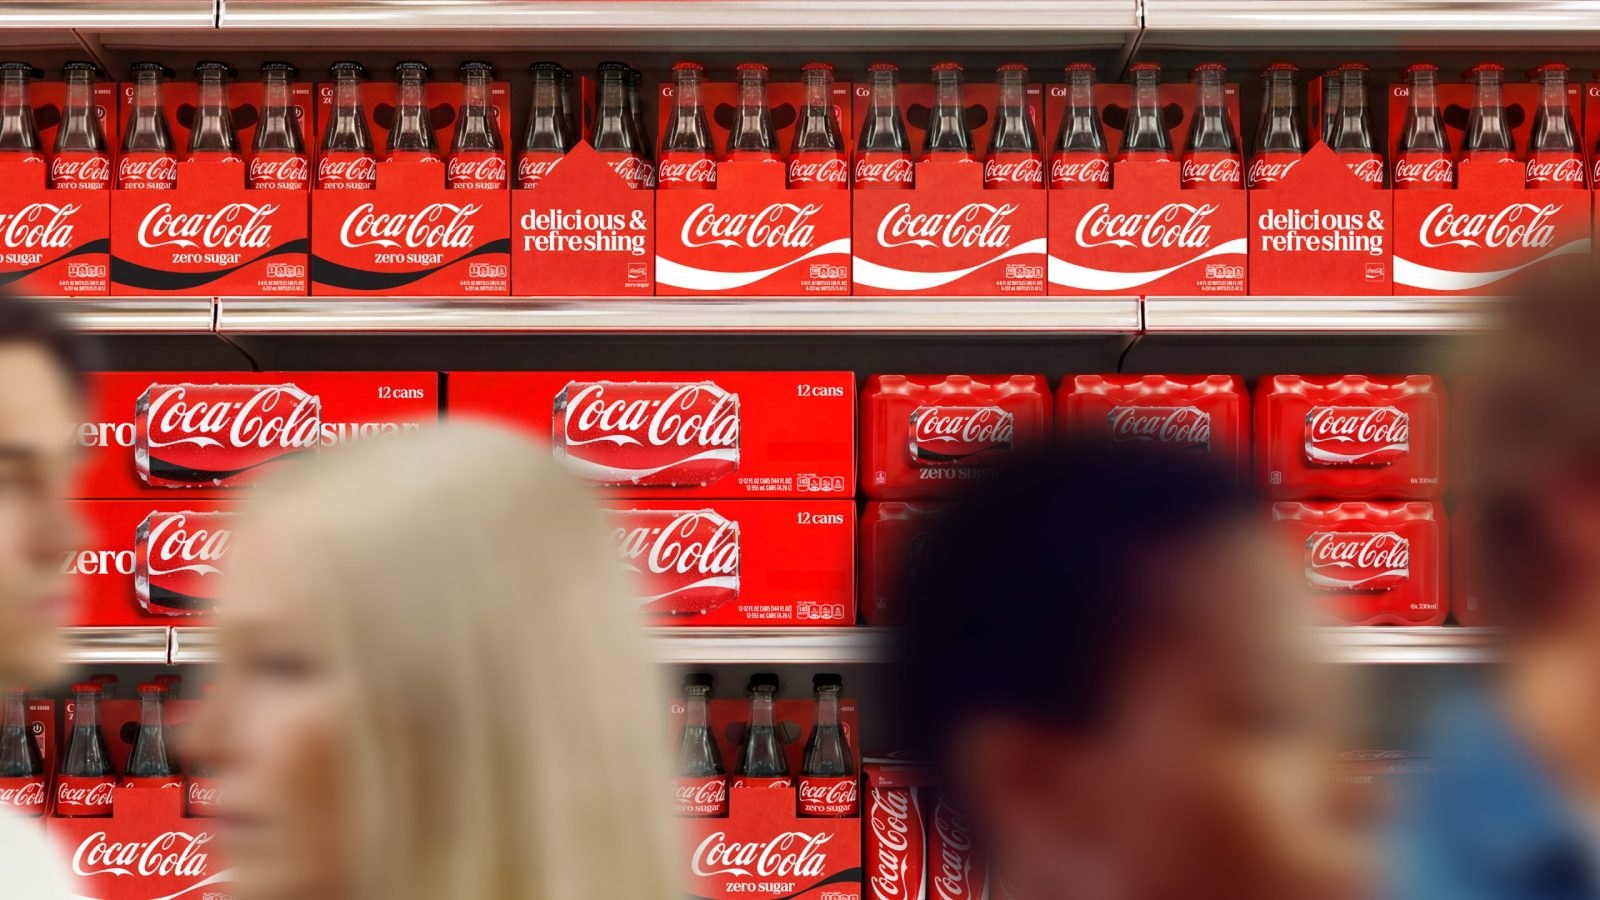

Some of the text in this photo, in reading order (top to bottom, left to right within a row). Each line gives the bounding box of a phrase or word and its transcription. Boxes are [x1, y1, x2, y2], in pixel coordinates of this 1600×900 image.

[52, 157, 109, 180] Coca-Cola
[119, 157, 177, 180] Coca-Cola
[250, 157, 307, 180] Coca-Cola
[319, 157, 376, 180] Coca-Cola
[448, 157, 506, 180] Coca-Cola
[659, 159, 716, 182] Coca-Cola
[789, 159, 847, 182] Coca-Cola
[856, 159, 913, 182] Coca-Cola
[985, 159, 1042, 182] Coca-Cola
[1052, 159, 1109, 182] Coca-Cola
[1182, 159, 1240, 182] Coca-Cola
[1395, 159, 1453, 182] Coca-Cola
[1526, 159, 1583, 182] Coca-Cola
[79, 182, 104, 190] sugar
[147, 182, 172, 190] sugar
[278, 182, 303, 190] sugar
[346, 182, 371, 190] sugar
[475, 182, 501, 190] sugar
[138, 203, 280, 248] Coca-Cola
[340, 203, 483, 248] Coca-Cola
[629, 209, 647, 230] &
[681, 203, 824, 248] Coca-Cola
[877, 203, 1019, 248] Coca-Cola
[1075, 203, 1219, 248] Coca-Cola
[1367, 209, 1385, 230] &
[1419, 203, 1564, 248] Coca-Cola
[6, 253, 42, 265] sugar
[172, 253, 241, 265] zero sugar
[375, 253, 444, 265] zero sugar
[378, 386, 424, 398] 12 cans
[797, 385, 844, 397] 12 cans
[148, 386, 320, 448] Coca-Cola
[565, 385, 739, 446] Coca-Cola
[916, 407, 1012, 442] Coca-Cola
[1312, 407, 1408, 442] Coca-Cola
[920, 467, 955, 479] zero
[797, 512, 844, 524] 12 cans
[1312, 533, 1408, 568] Coca-Cola
[800, 780, 856, 803] Coca-Cola
[827, 804, 851, 812] sugar
[72, 832, 216, 876] Coca-Cola
[691, 832, 835, 876] Coca-Cola
[726, 882, 795, 894] zero sugar
